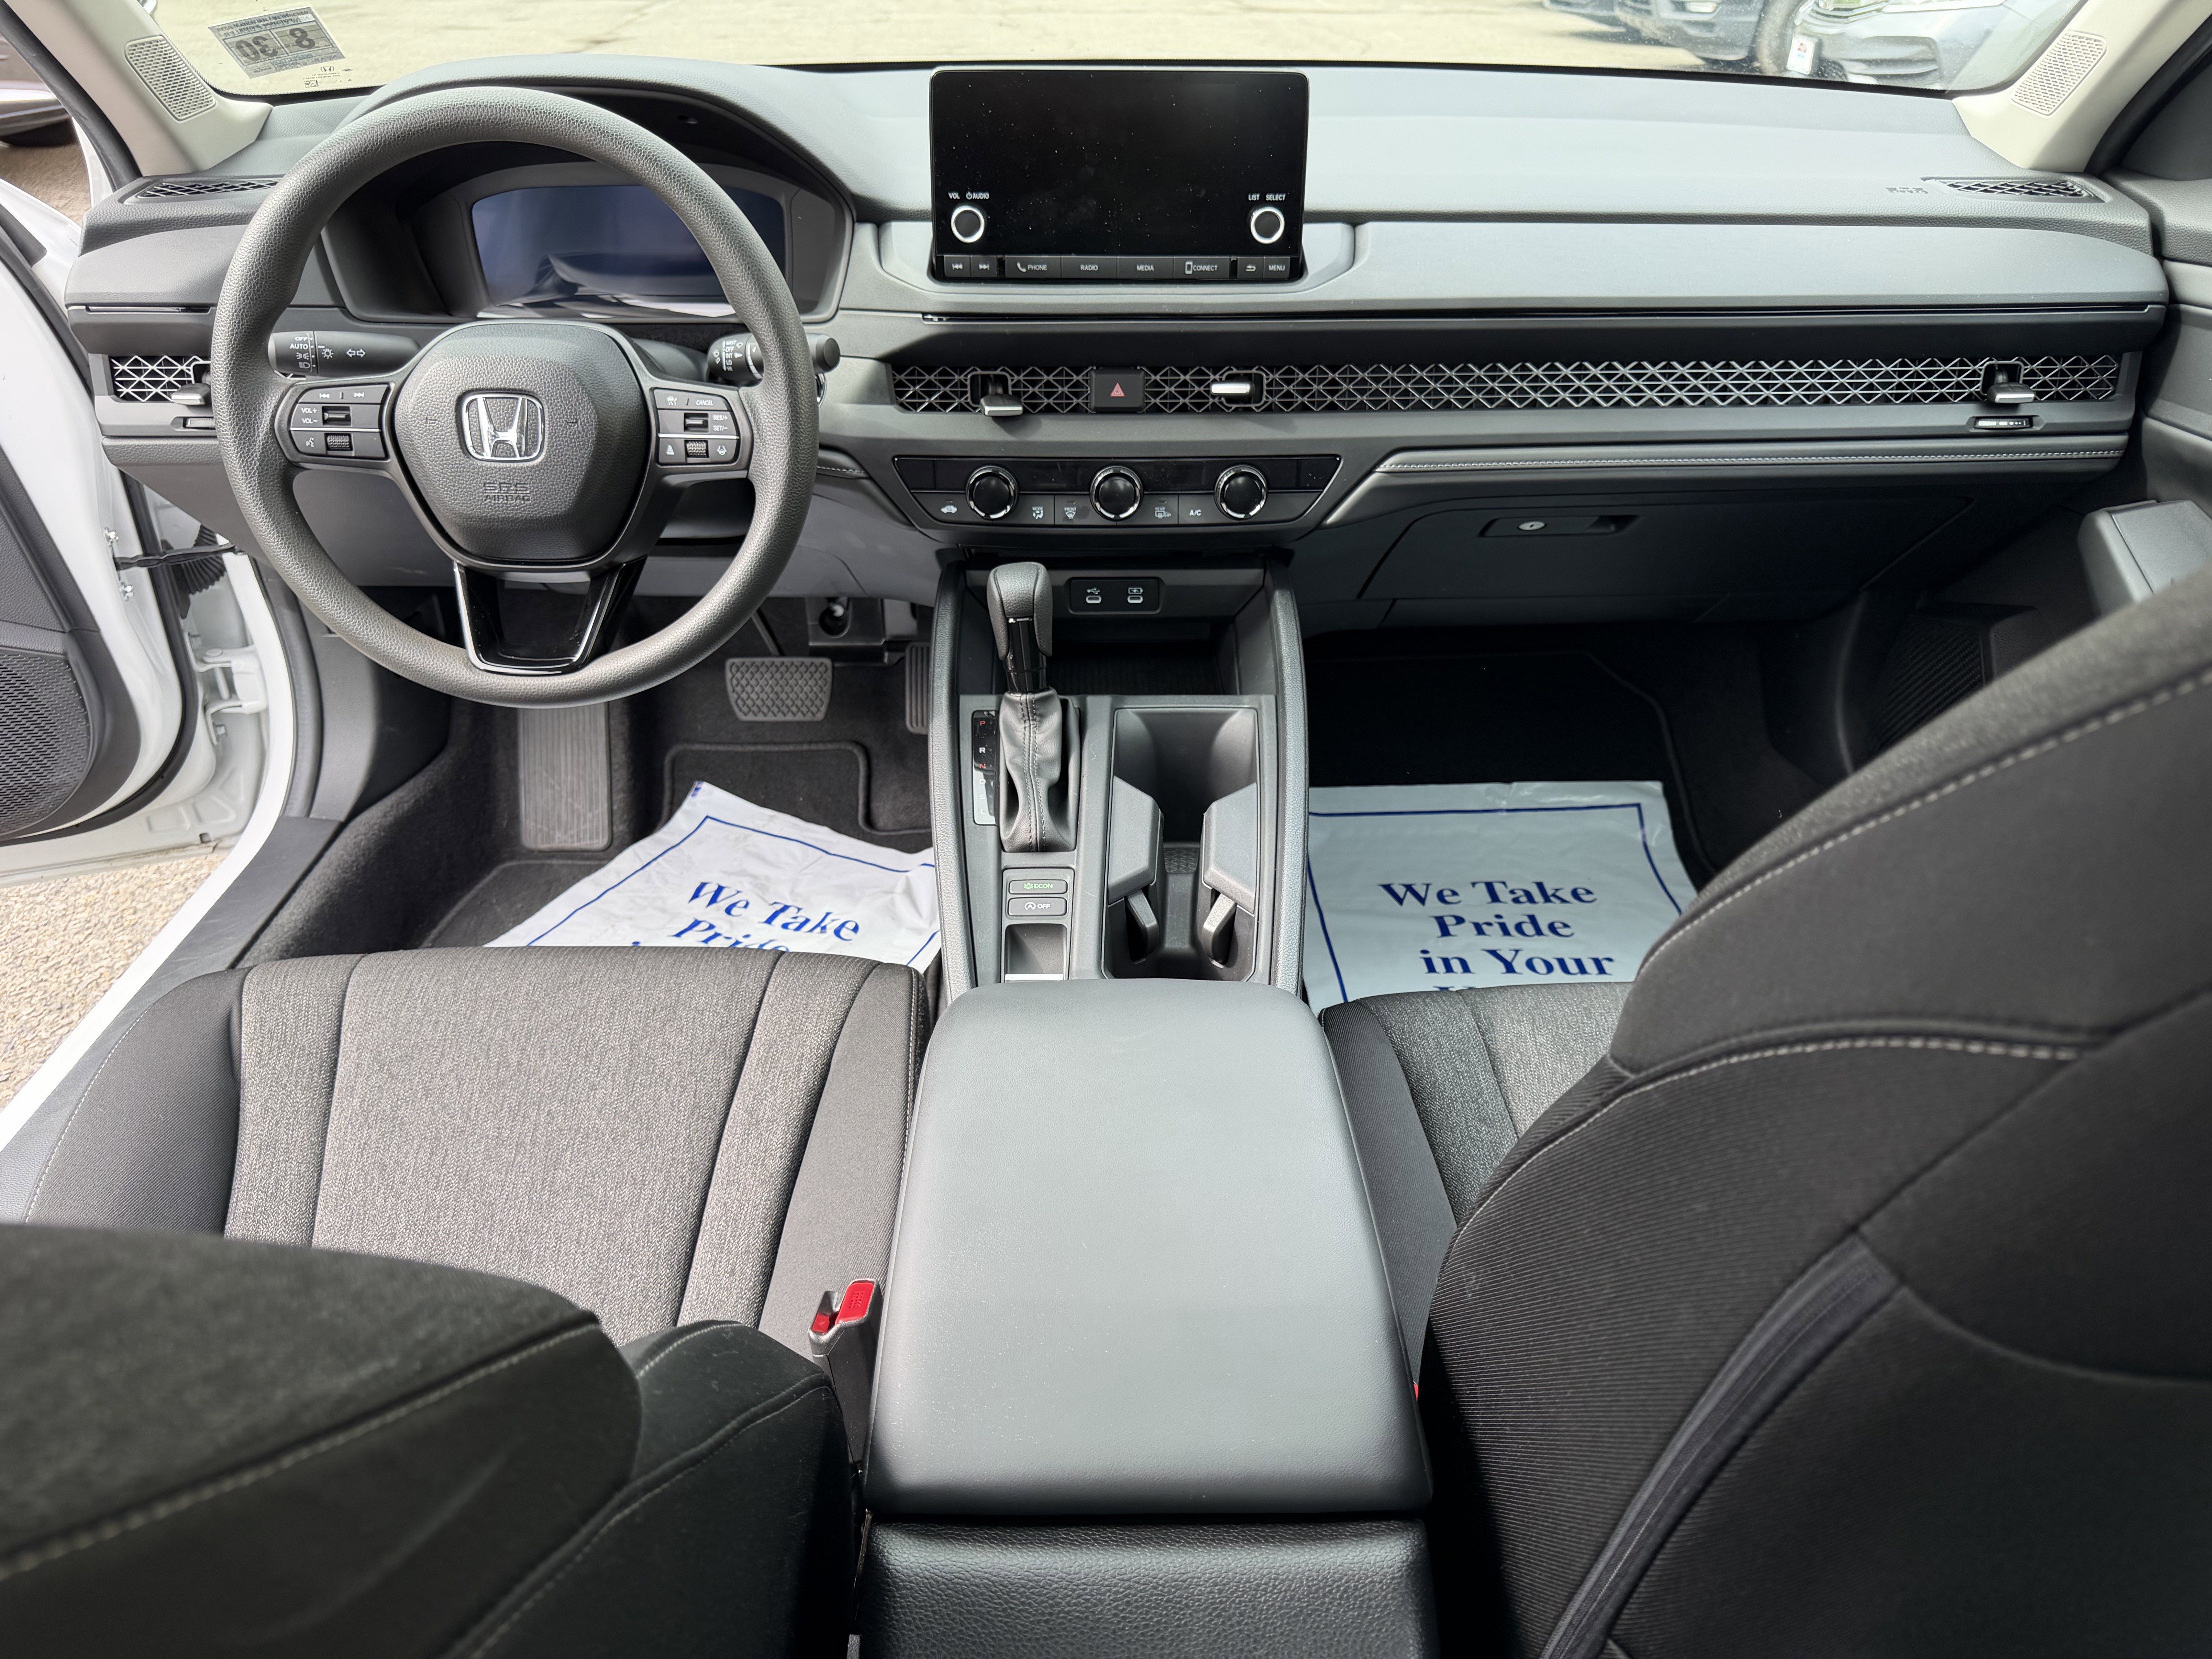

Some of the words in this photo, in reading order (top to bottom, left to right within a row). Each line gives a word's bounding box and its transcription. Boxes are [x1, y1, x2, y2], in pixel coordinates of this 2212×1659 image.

[1377, 883, 1462, 906] We
[1470, 881, 1597, 905] Take
[688, 881, 750, 917] We
[759, 902, 860, 941] Take
[1429, 913, 1575, 938] Pride
[1419, 949, 1475, 975] in
[1481, 948, 1615, 976] Your
